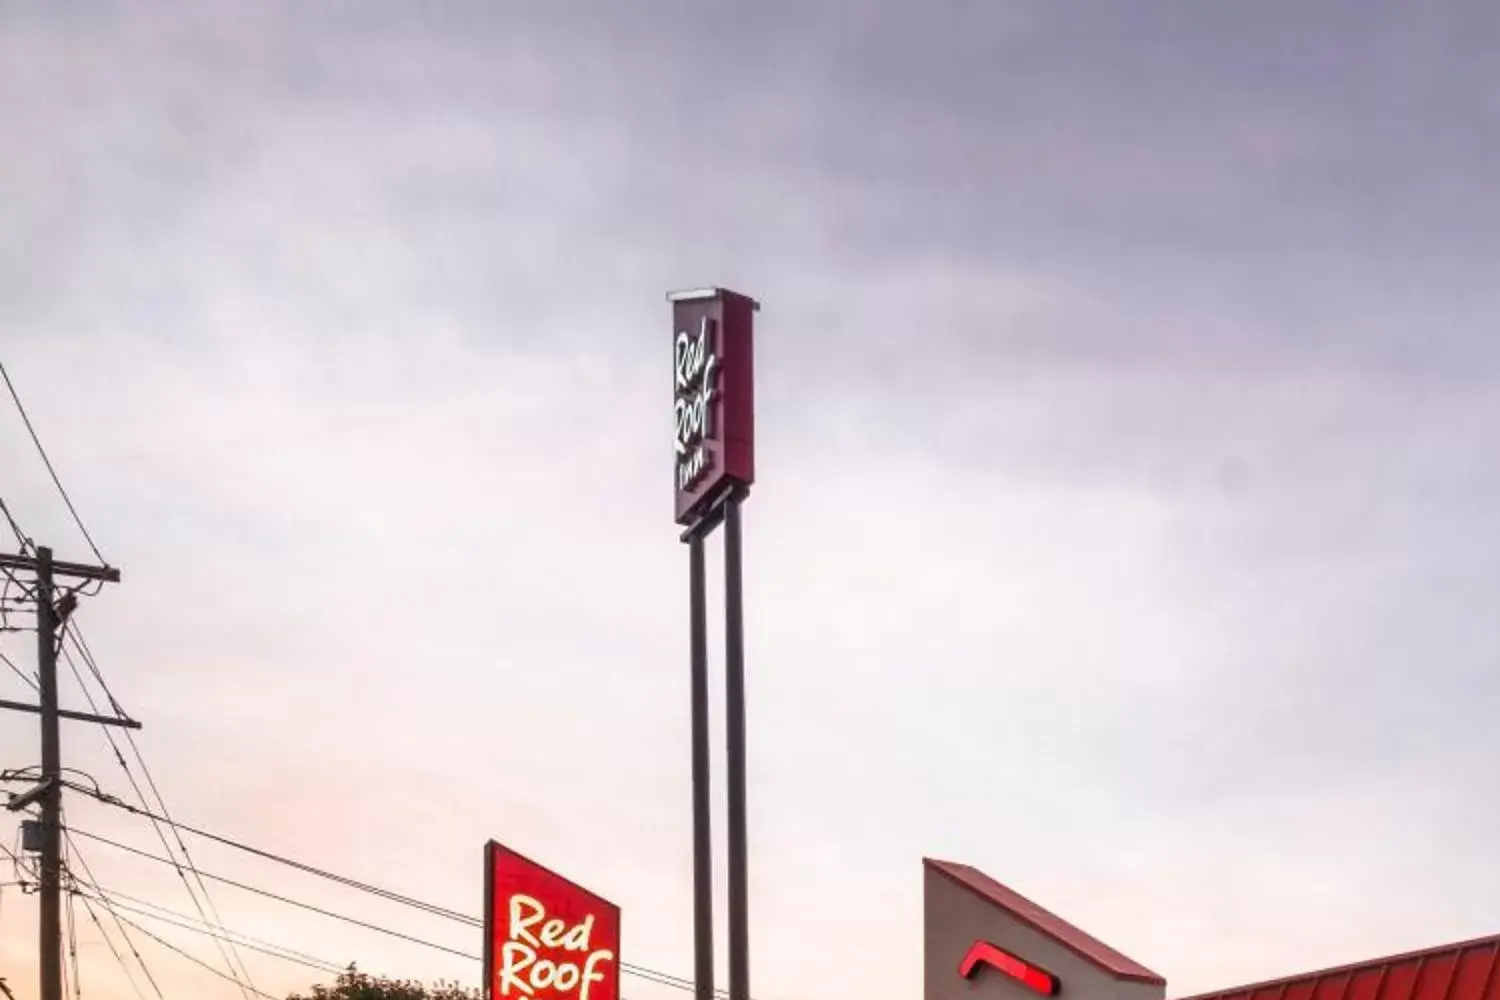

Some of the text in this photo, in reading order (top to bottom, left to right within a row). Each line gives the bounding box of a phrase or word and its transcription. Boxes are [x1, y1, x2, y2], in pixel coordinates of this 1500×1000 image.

[676, 315, 706, 391] Red
[674, 354, 714, 453] Roof
[509, 893, 595, 951] Red
